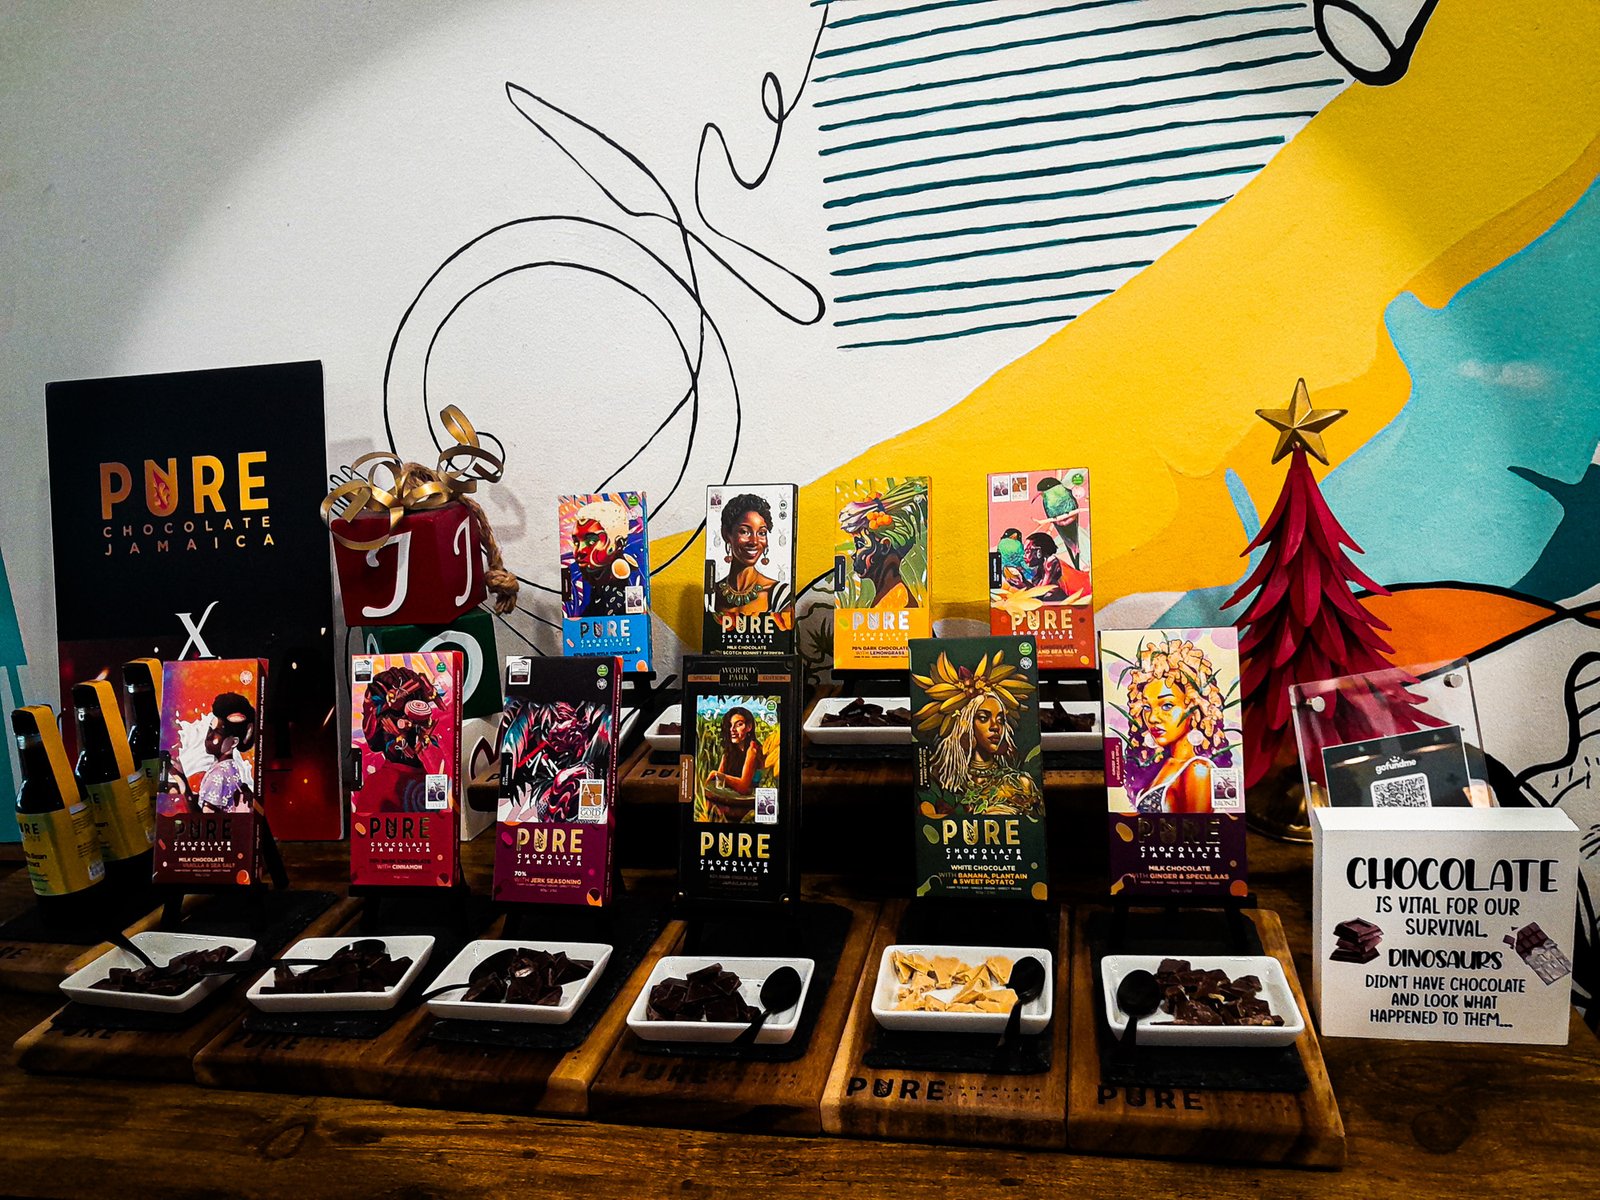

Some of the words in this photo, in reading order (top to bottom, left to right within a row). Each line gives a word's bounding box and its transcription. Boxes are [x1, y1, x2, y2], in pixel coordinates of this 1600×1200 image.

[100, 451, 269, 520] PURE
[103, 516, 271, 538] CHOCOLATE
[105, 533, 274, 555] JAMAICA
[580, 619, 631, 638] PURE
[722, 615, 774, 634] PURE
[852, 610, 910, 630] PURE
[1011, 609, 1073, 630] PURE
[721, 666, 757, 674] WORTHY
[640, 769, 681, 778] PU
[1375, 758, 1417, 775] gofundme
[580, 808, 600, 816] GOLD
[174, 818, 232, 840] PURE
[369, 817, 431, 839] PURE
[942, 819, 1021, 846] PURE
[1137, 817, 1221, 845] PURE
[516, 827, 584, 853] PURE
[700, 831, 771, 859] PURE
[517, 853, 582, 861] CHOCOLATE
[700, 859, 768, 868] CHOCOLATE
[700, 865, 769, 874] JAMAICA
[938, 871, 957, 879] WITH
[973, 864, 1016, 872] CHOCOLATE
[1185, 873, 1230, 881] SPECULAAS
[1346, 857, 1559, 892] CHOCOLATE
[1375, 896, 1393, 913] IS
[1399, 896, 1440, 914] VITAL
[1446, 897, 1478, 915] FOR
[1484, 898, 1520, 916] OUR
[1405, 918, 1488, 938] SURVIVAL.
[1388, 948, 1504, 970] DINOSAURS
[1365, 974, 1408, 989] DIDN'T
[1413, 976, 1445, 991] HAVE
[1450, 976, 1526, 993] CHOCOLATE
[1391, 993, 1419, 1007] AND
[1424, 993, 1459, 1008] LOOK
[1463, 995, 1498, 1010] WHAT
[1370, 1009, 1438, 1025] HAPPENED
[1442, 1011, 1459, 1026] TO
[845, 1077, 946, 1101] PURE
[1097, 1084, 1204, 1111] PURE
